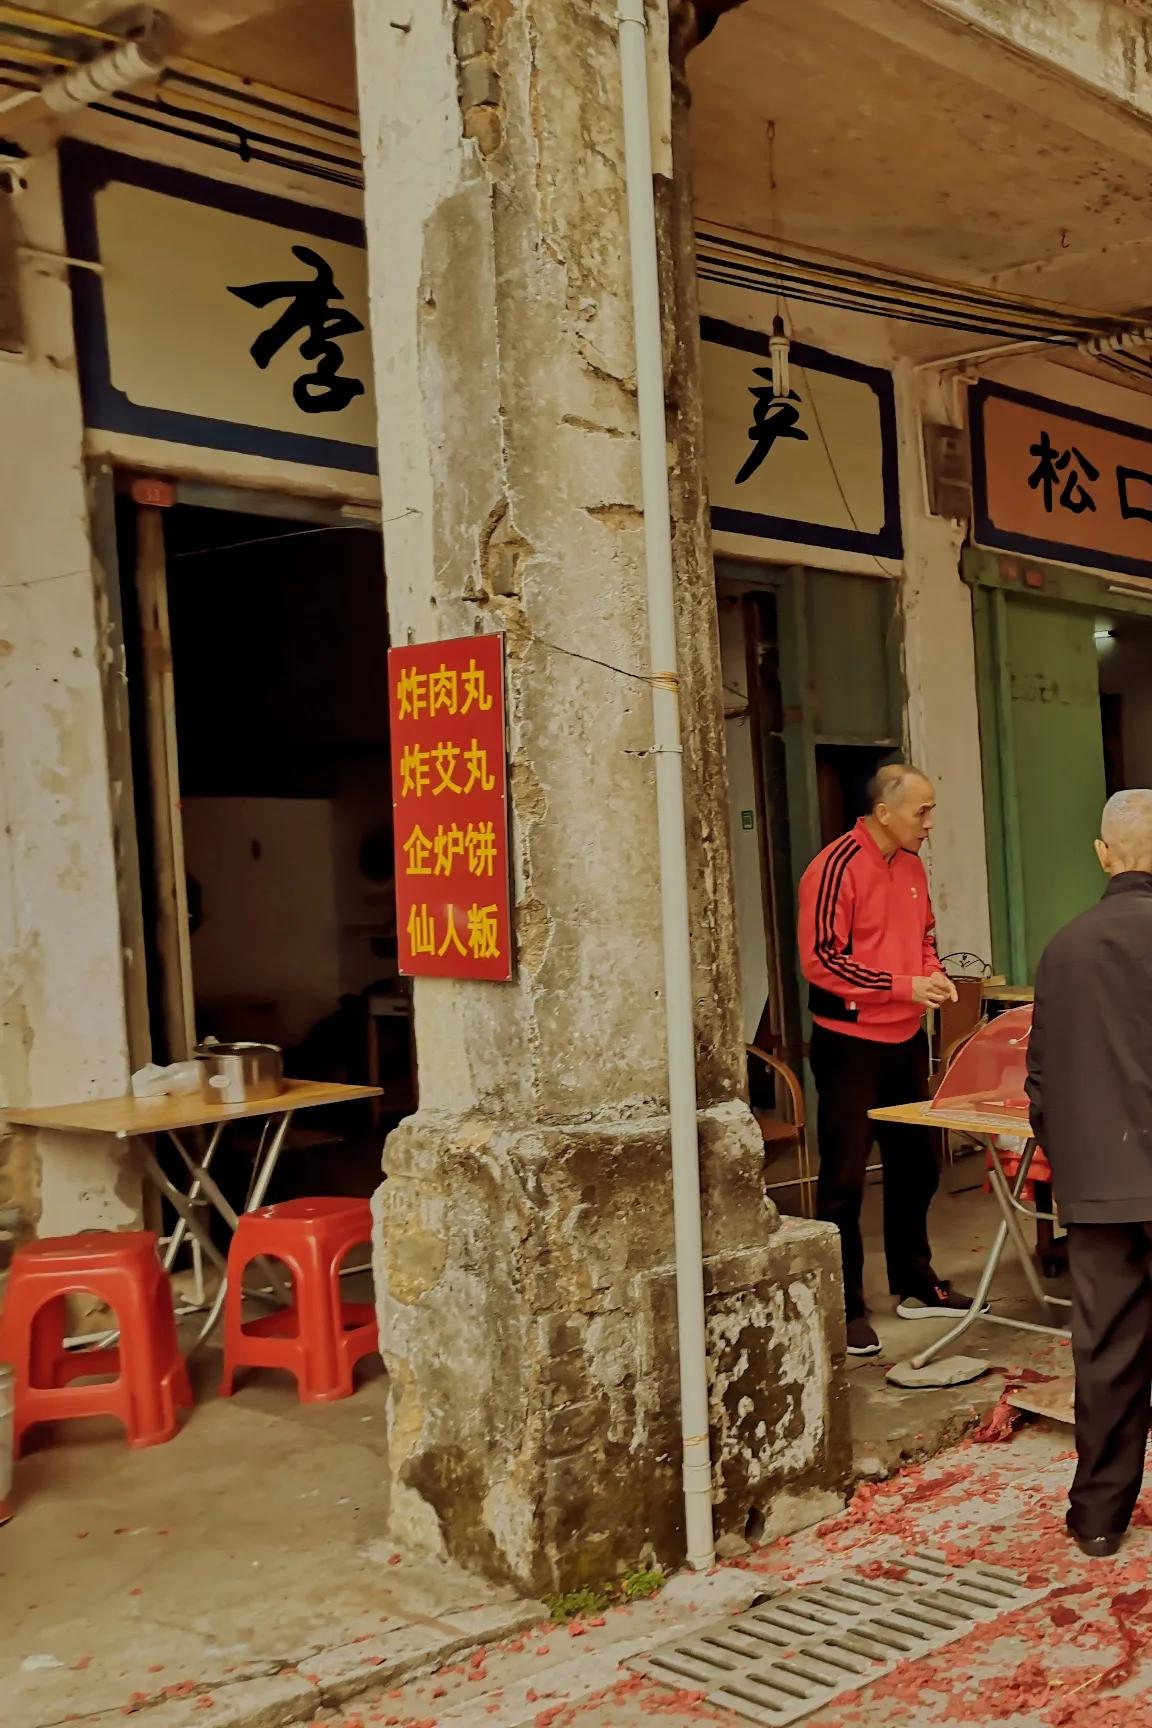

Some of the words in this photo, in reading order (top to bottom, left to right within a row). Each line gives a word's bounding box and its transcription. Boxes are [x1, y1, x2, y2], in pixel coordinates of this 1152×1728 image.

[397, 659, 493, 721] 炸肉丸
[400, 739, 495, 798] 炸艾丸
[403, 821, 497, 877] 企炉饼
[407, 903, 501, 960] 仙人粄
